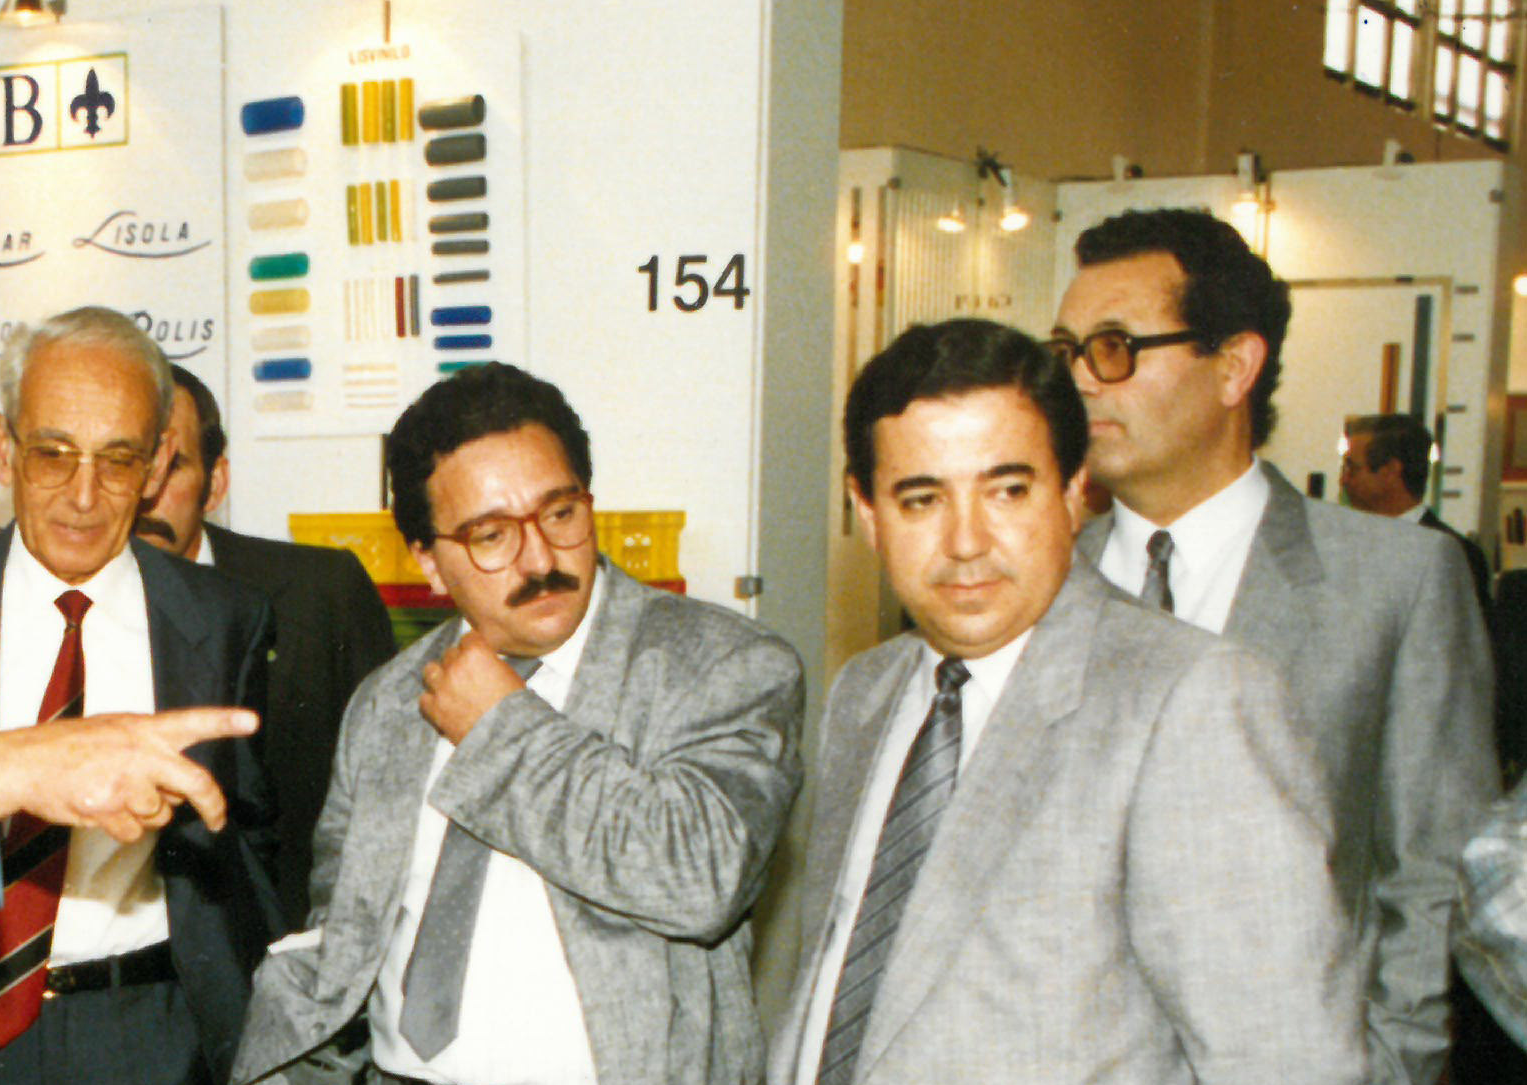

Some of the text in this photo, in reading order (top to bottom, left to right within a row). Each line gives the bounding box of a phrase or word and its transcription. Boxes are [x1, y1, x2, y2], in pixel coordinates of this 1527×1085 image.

[2, 74, 44, 146] B
[72, 210, 213, 258] LISOLA
[637, 253, 751, 312] 154
